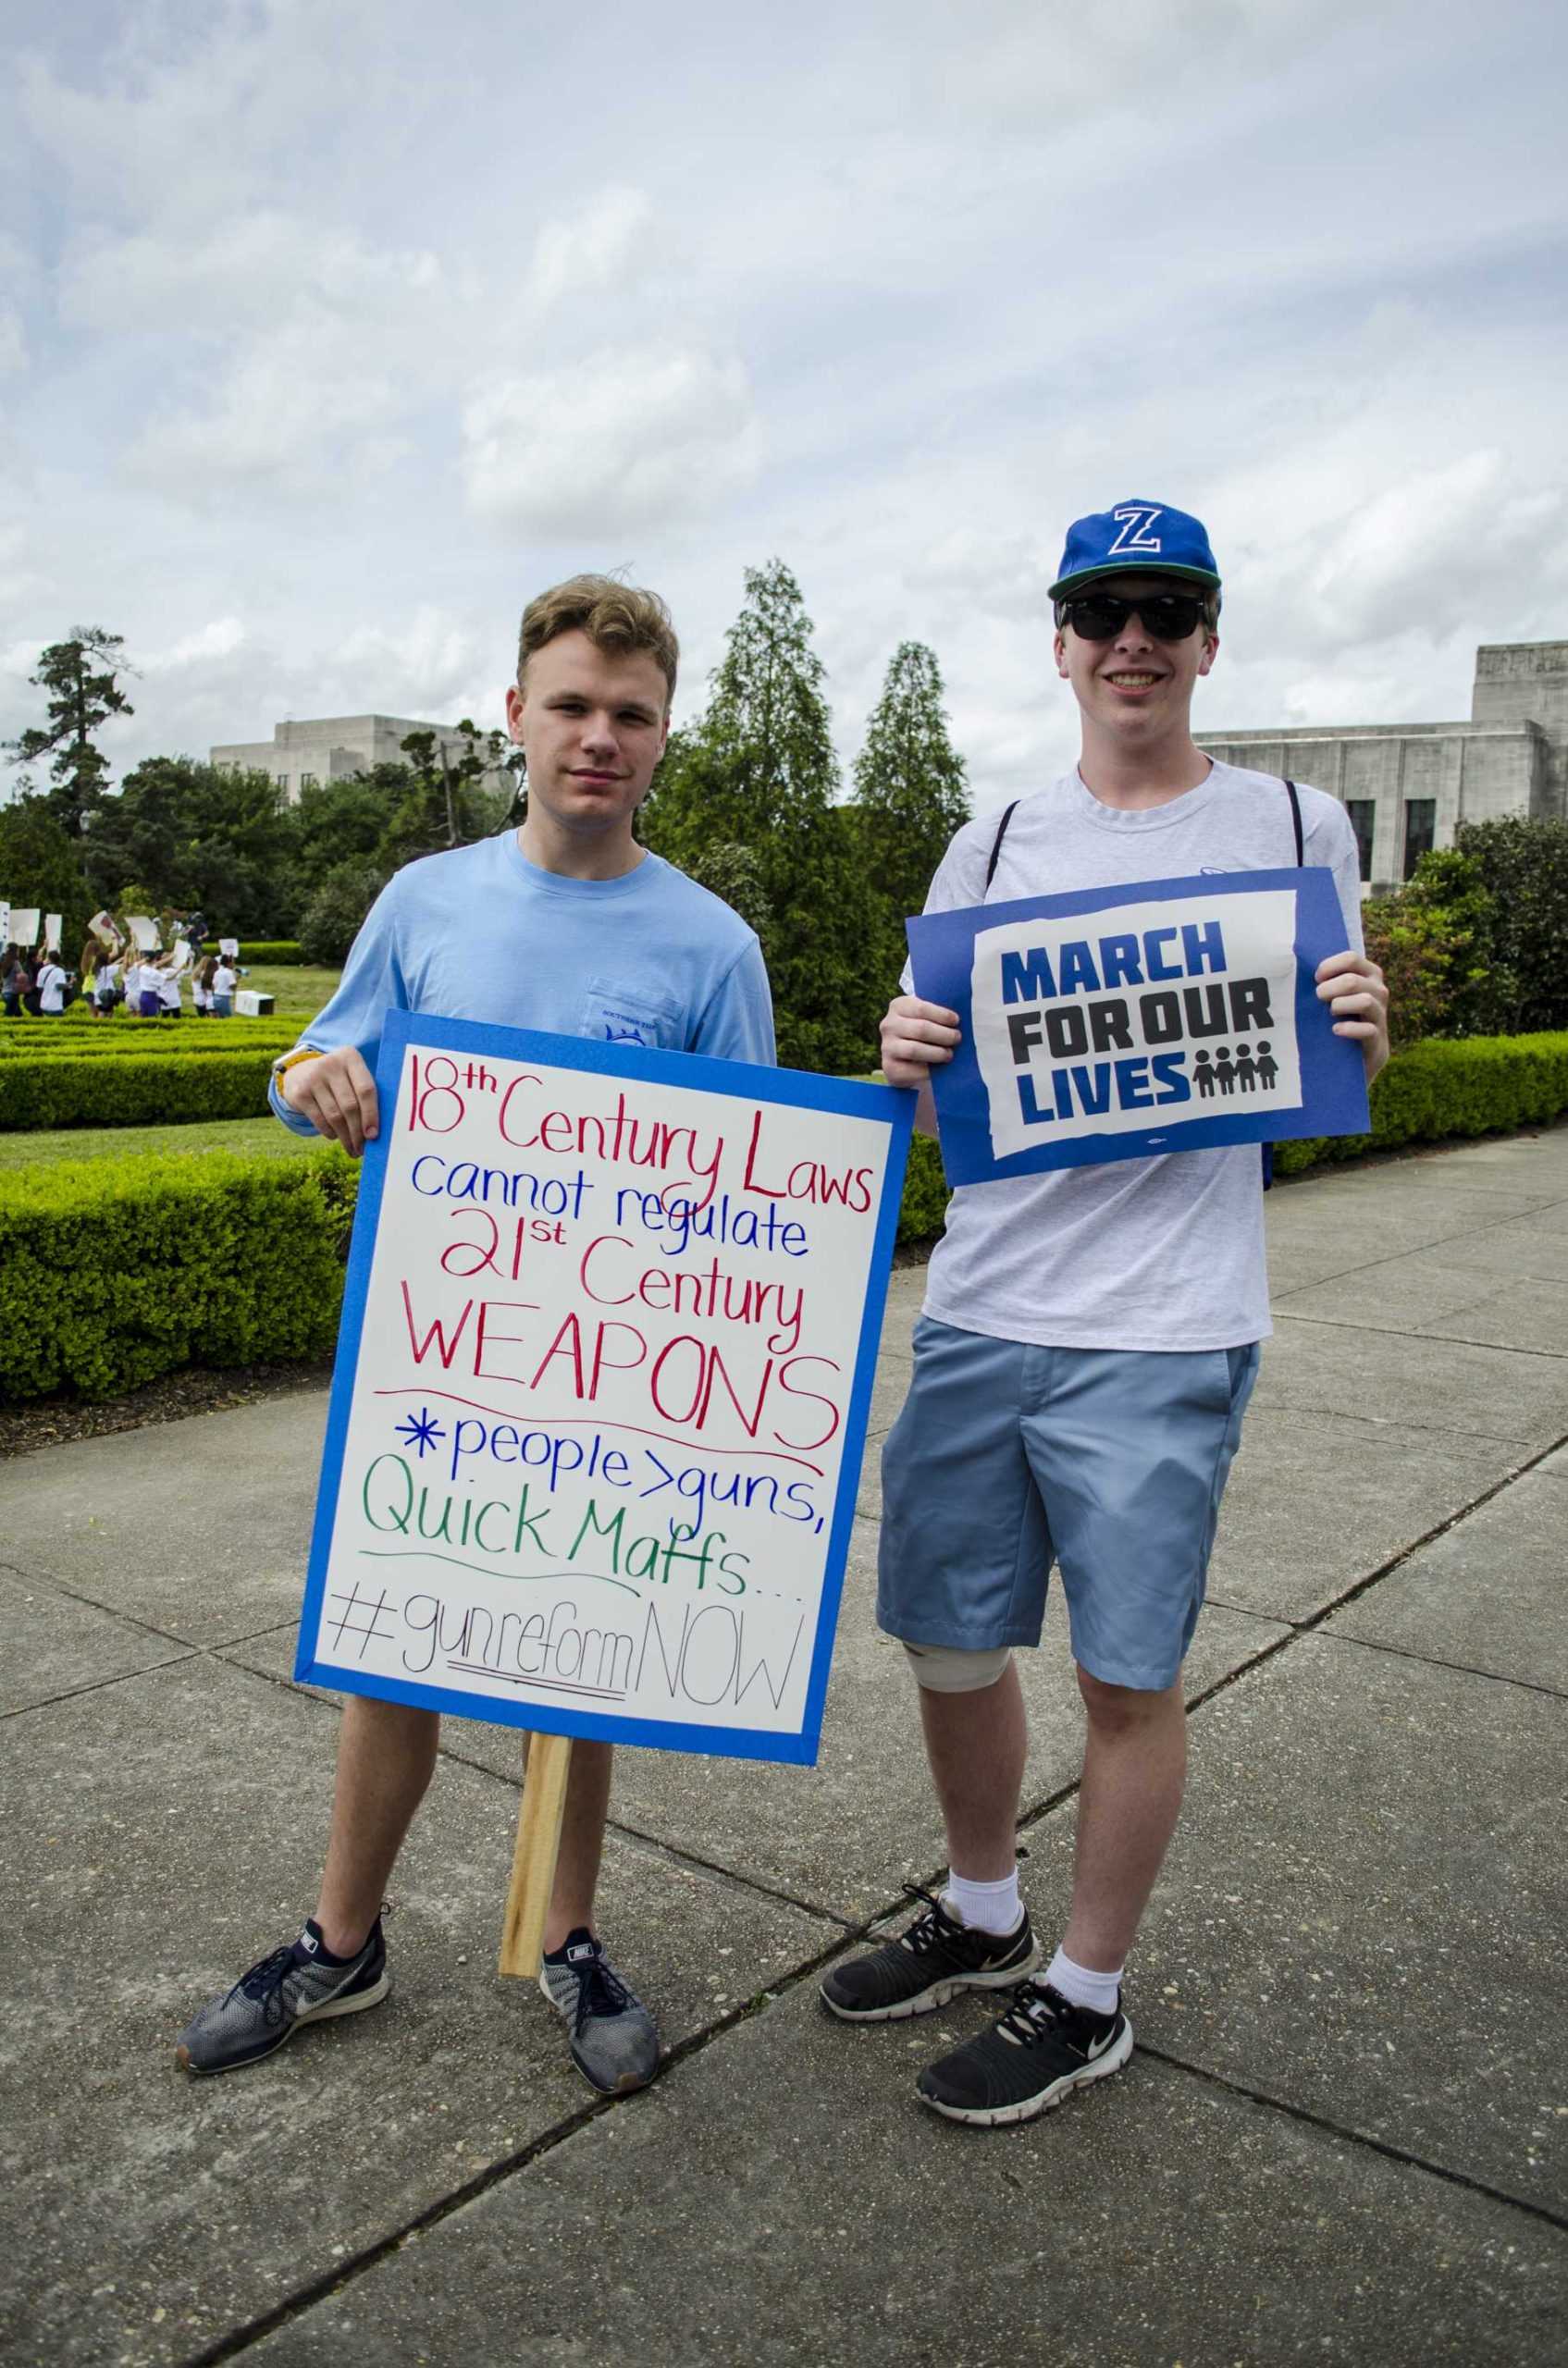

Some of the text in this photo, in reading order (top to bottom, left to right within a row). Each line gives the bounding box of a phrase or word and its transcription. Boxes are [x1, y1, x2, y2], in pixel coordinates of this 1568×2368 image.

[1108, 508, 1162, 555] Z
[1001, 921, 1226, 1005] MARCH
[1007, 977, 1274, 1065] FOR OUR
[408, 1054, 874, 1217] 18th Century Laws
[1017, 1051, 1191, 1125] LIVES
[412, 1155, 809, 1255] cannot regulate
[440, 1208, 804, 1354] 21st Century
[401, 1280, 840, 1449] WEAPONS
[363, 1453, 556, 1558] Quick
